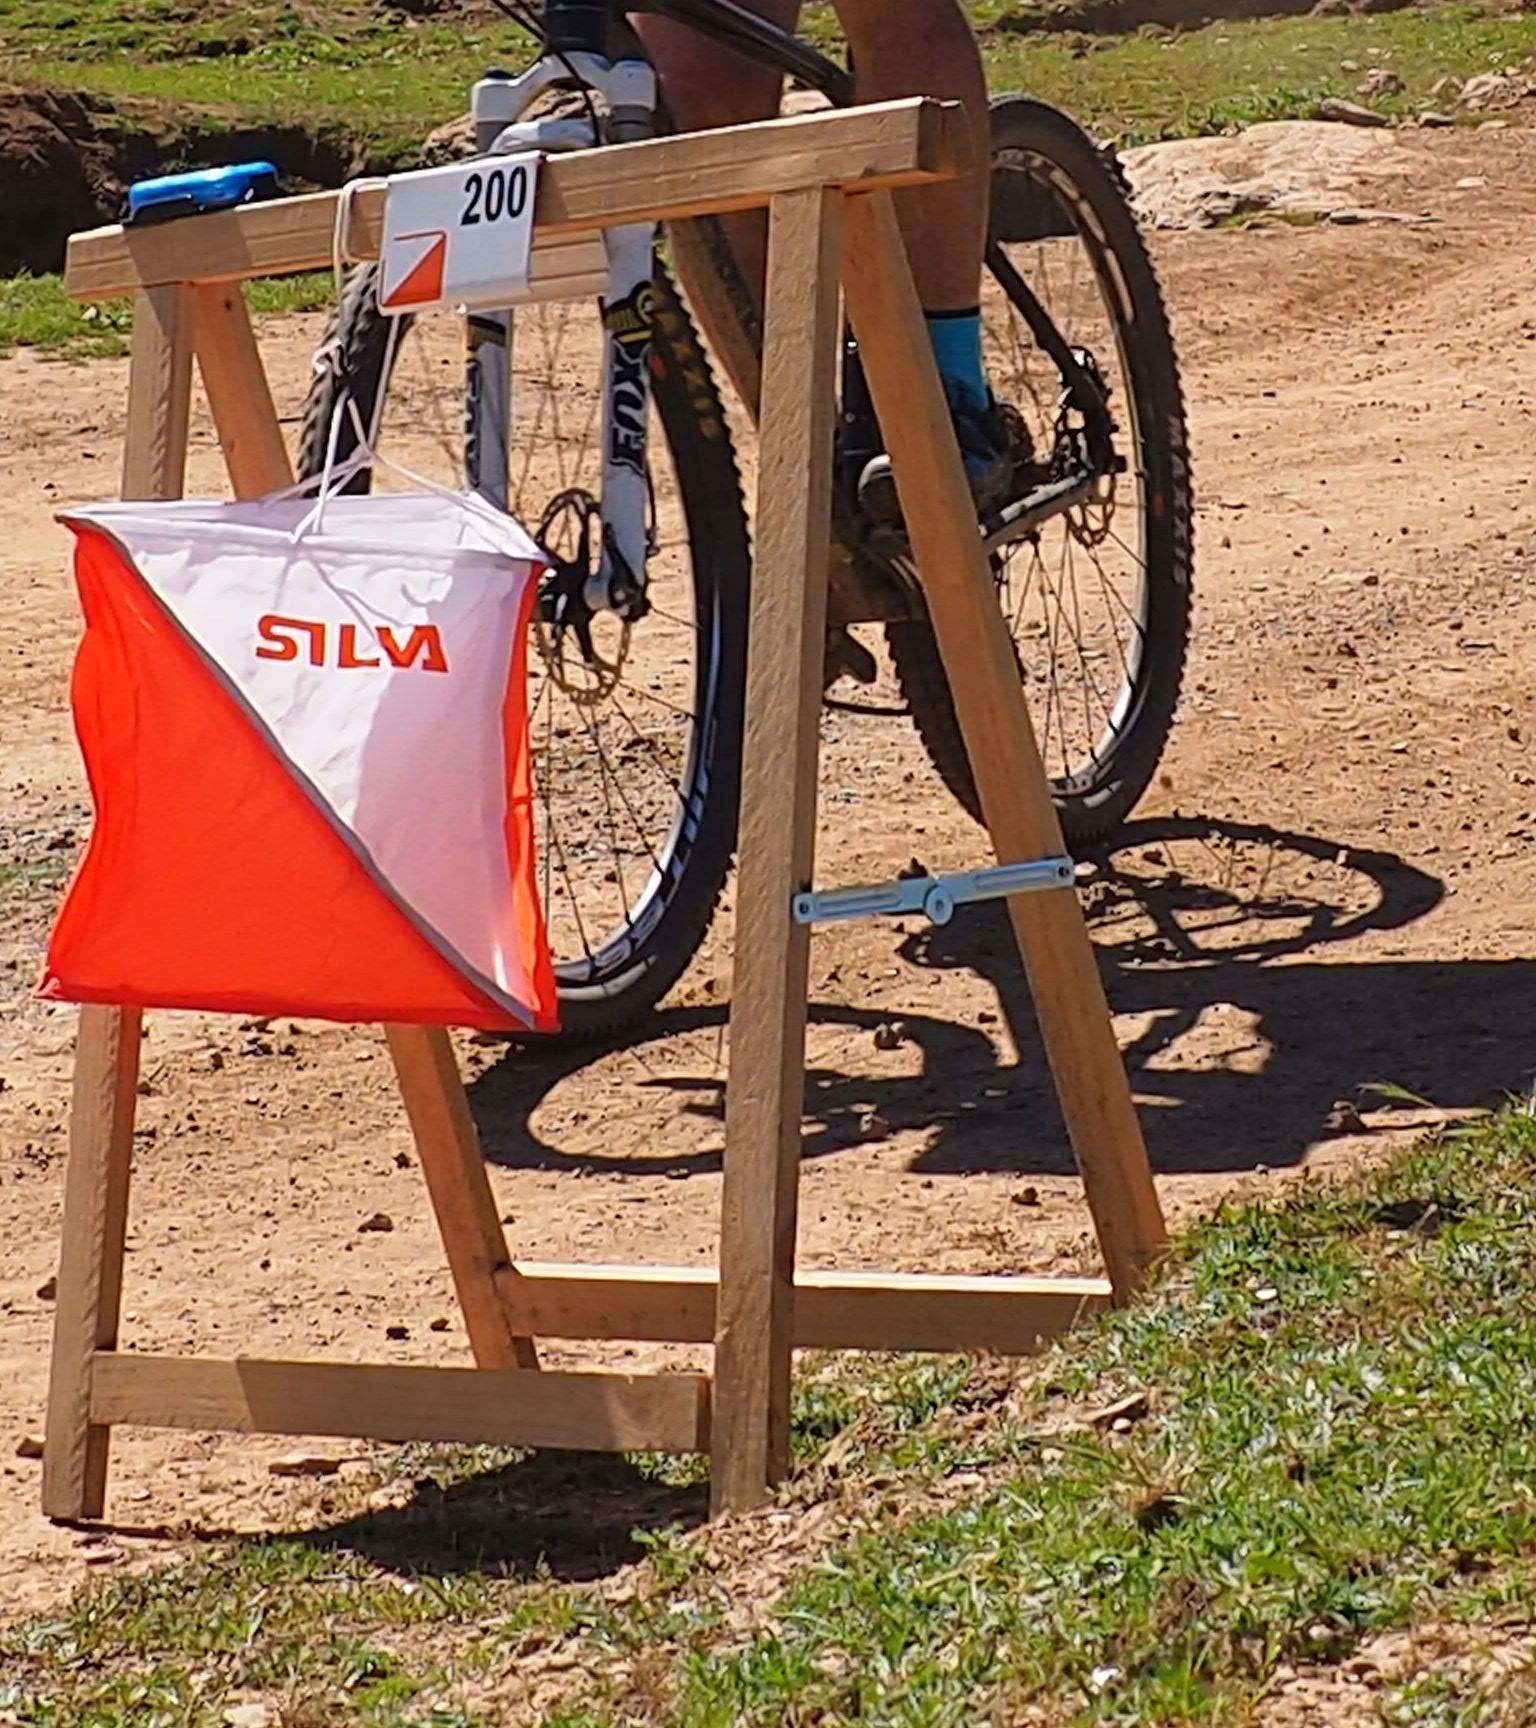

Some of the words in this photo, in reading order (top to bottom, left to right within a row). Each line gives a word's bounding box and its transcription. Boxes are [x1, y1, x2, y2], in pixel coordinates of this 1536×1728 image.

[460, 166, 527, 227] 200
[611, 344, 647, 470] FOX
[255, 614, 449, 673] SILVA
